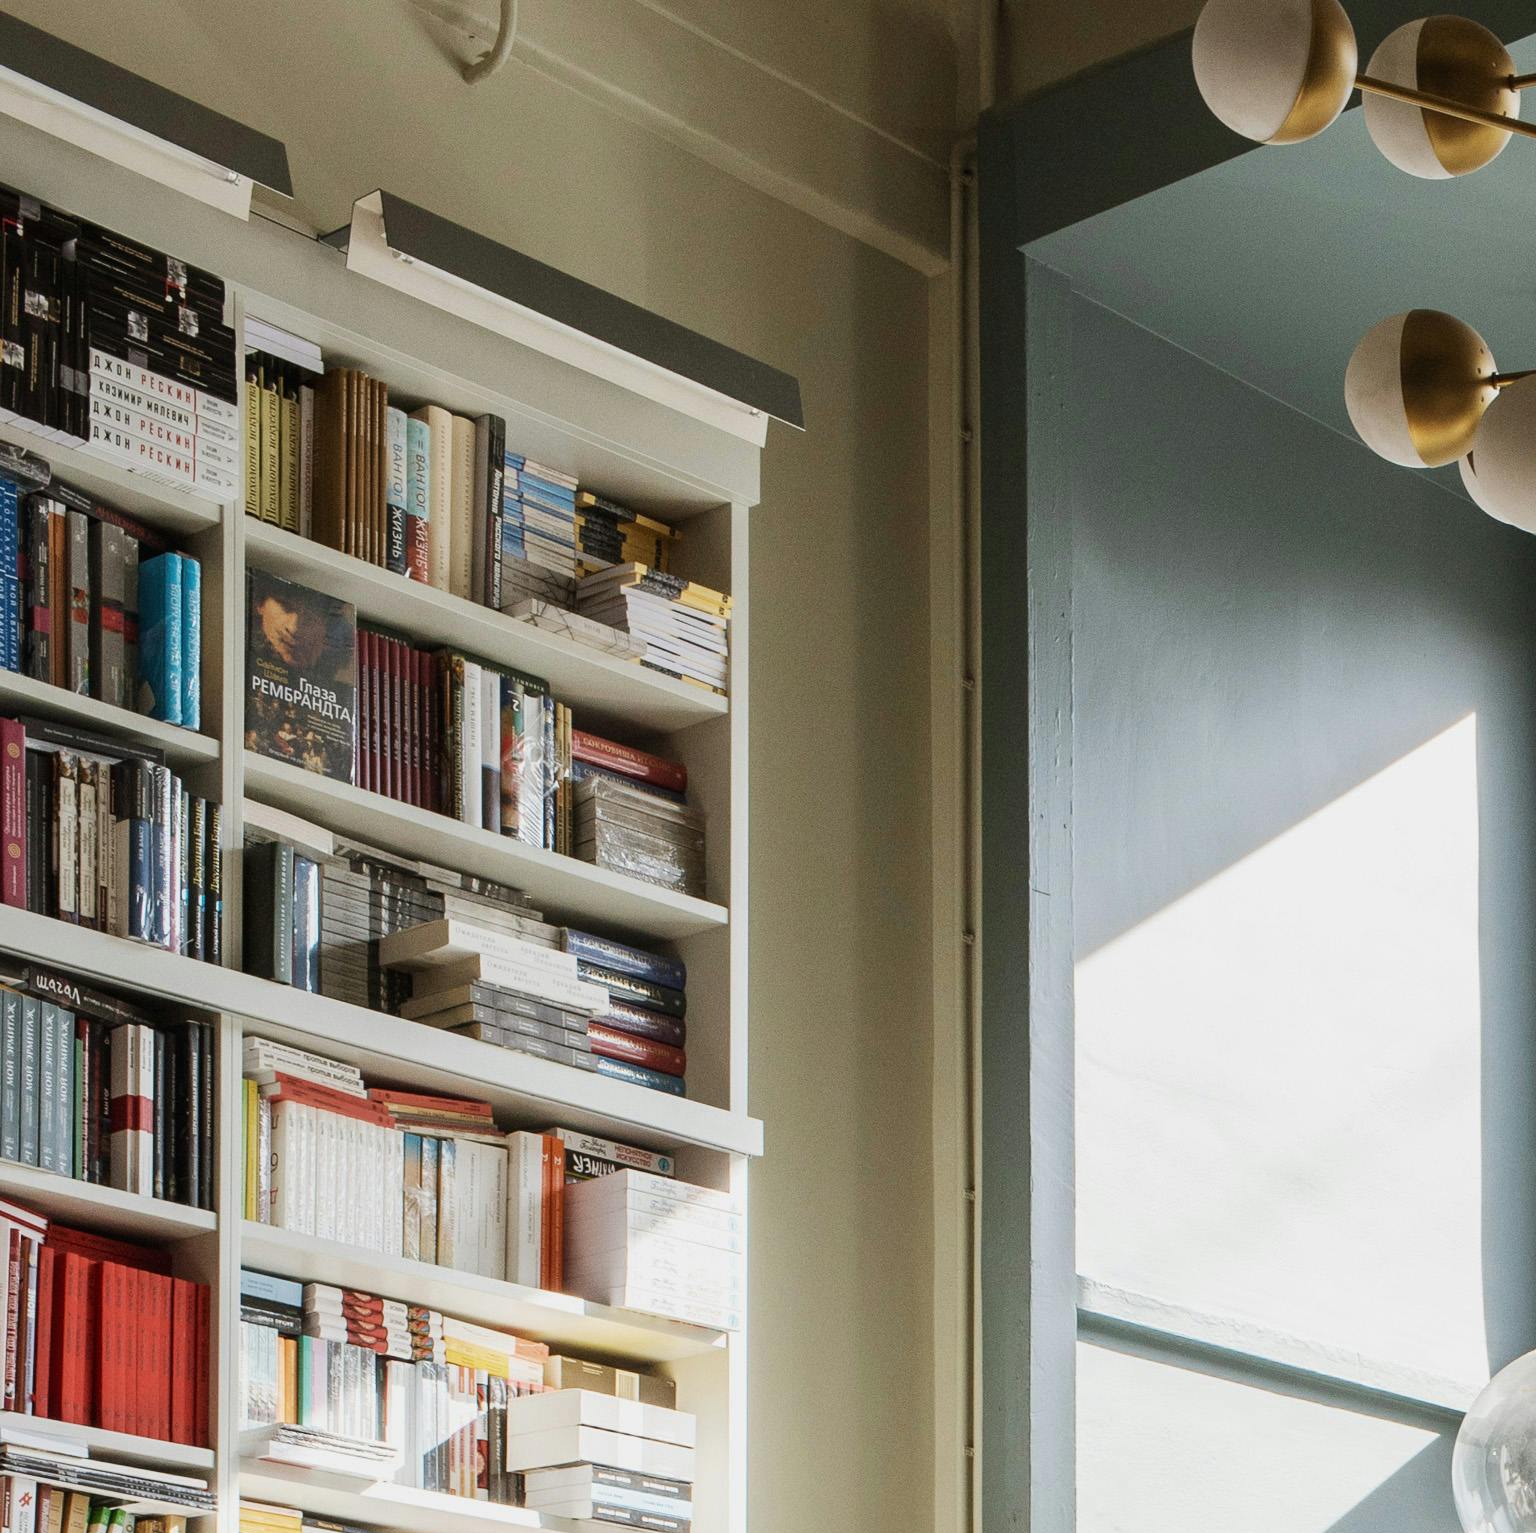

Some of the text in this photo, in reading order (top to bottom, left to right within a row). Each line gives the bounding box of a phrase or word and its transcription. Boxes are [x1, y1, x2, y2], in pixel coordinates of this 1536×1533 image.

[93, 353, 192, 404] ДЖОН РЕСКИН
[92, 400, 192, 450] ДЖОН РЕСКИН
[92, 424, 191, 475] ДЖОН РЕСКИН
[391, 506, 404, 559] ЖИЗНЬ
[251, 675, 353, 724] РЕМБРАНДТА
[299, 677, 337, 703] Глаза
[6, 1001, 17, 1086] МОЙ ЭРМИТАЖ
[26, 1007, 36, 1092] МОЙ ЭРМИТАЖ
[45, 1013, 55, 1097] МОЙ ЭРМИТАЖ
[60, 1020, 70, 1103] МОЙ ЭРМИТАЖ
[304, 1053, 357, 1076] против выборов
[307, 1066, 360, 1087] против выборов
